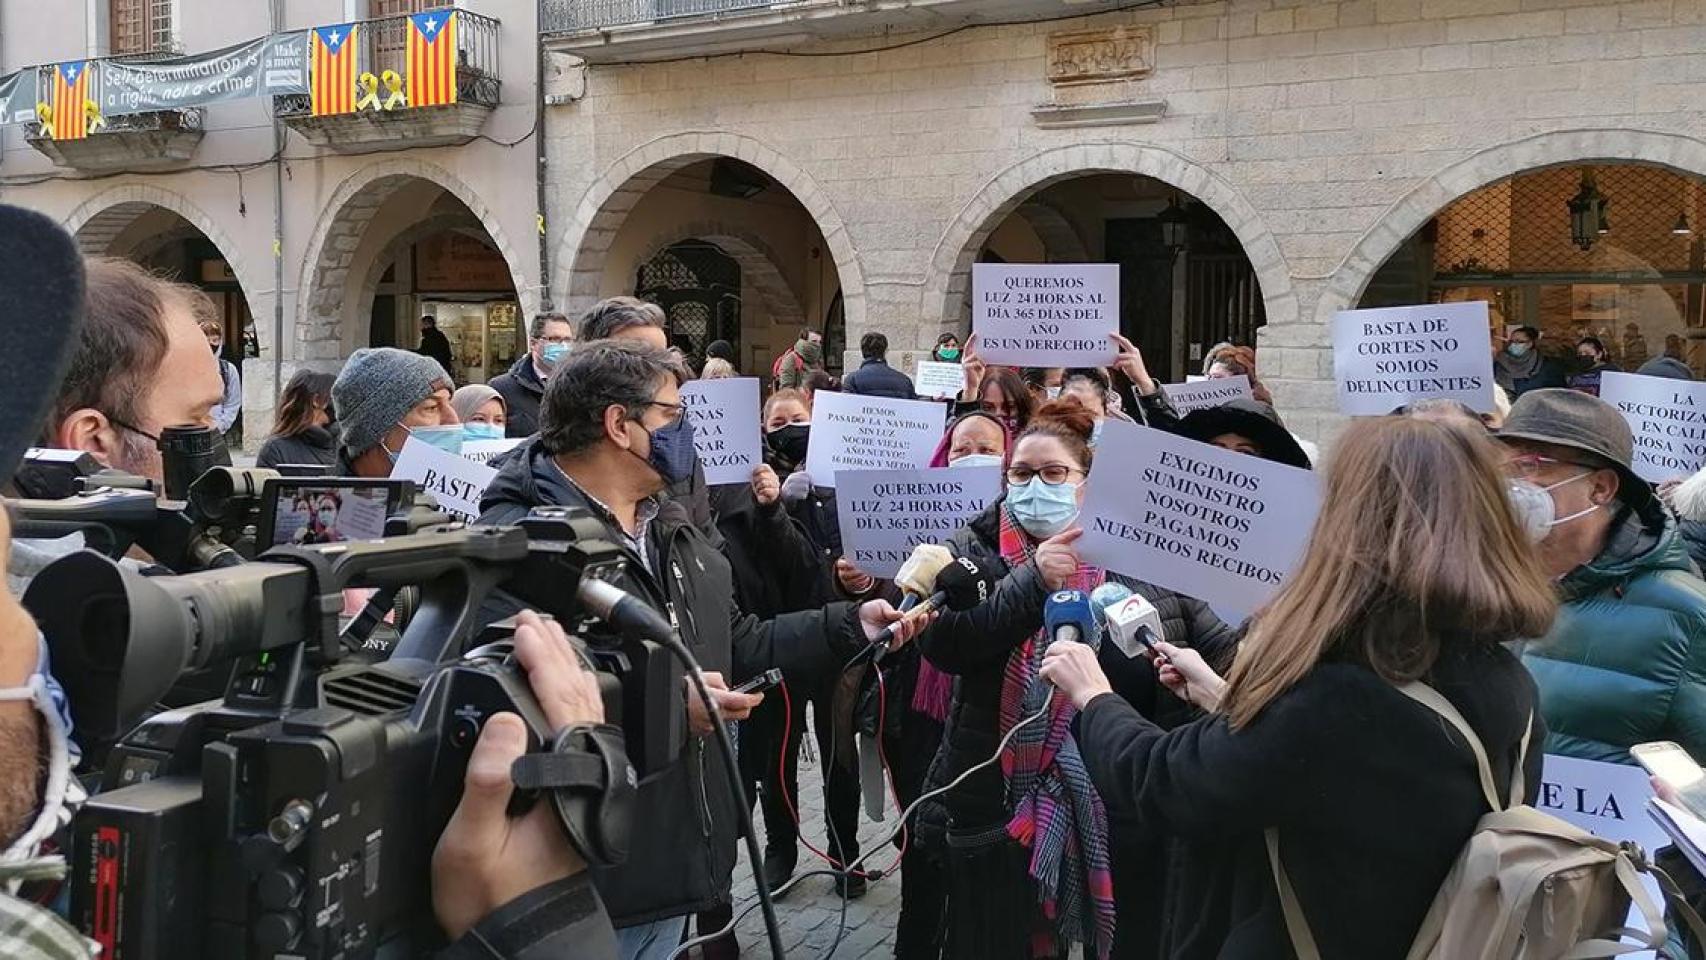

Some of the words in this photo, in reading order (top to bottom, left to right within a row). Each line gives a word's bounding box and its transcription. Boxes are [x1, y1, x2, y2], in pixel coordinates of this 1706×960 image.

[245, 49, 258, 66] is
[108, 94, 116, 106] a
[162, 81, 190, 100] not
[192, 84, 204, 96] a
[208, 73, 254, 95] crime
[1004, 277, 1084, 290] QUEREMOS
[985, 292, 1010, 304] LUZ
[1017, 293, 1031, 304] 24
[1034, 293, 1083, 304] HORAS
[1086, 293, 1107, 304] AL
[987, 305, 1010, 319] DÍA
[1014, 308, 1034, 319] 365
[1074, 308, 1104, 320] DEL
[1029, 322, 1060, 335] AÑO
[1363, 321, 1417, 337] BASTA
[1423, 318, 1450, 333] DE
[983, 338, 1000, 349] ES
[1003, 338, 1022, 349] UN
[1025, 339, 1095, 351] DERECHO
[1098, 340, 1107, 351] !!
[1357, 339, 1426, 356] CORTES
[1430, 338, 1459, 353] NO
[1375, 358, 1439, 375] SOMOS
[1345, 375, 1482, 394] DELINCUENTES
[1171, 386, 1243, 403] CIUDADANOS
[1673, 392, 1695, 406] LA
[861, 406, 897, 417] HEMOS
[827, 412, 865, 424] PASADO
[869, 418, 881, 426] LA
[885, 419, 929, 431] NAVIDAD
[1641, 421, 1662, 434] EN
[713, 425, 723, 435] A
[858, 427, 874, 436] SIN
[876, 428, 896, 437] LUZ
[842, 434, 874, 446] NOCHE
[846, 445, 866, 456] AÑO
[1682, 443, 1706, 457] NO
[842, 456, 875, 467] HORAS
[876, 459, 882, 467] Y
[885, 460, 916, 470] MEDIA
[1159, 451, 1261, 492] EXIGIMOS
[873, 481, 963, 497] QUEREMOS
[1141, 467, 1266, 515] SUMINISTRO
[852, 500, 882, 513] LUZ
[889, 500, 905, 513] 24
[908, 499, 963, 513] HORAS
[1143, 489, 1252, 533] NOSOTROS
[856, 514, 883, 530] DÍA
[887, 517, 910, 530] 365
[914, 514, 951, 530] DÍAS
[905, 530, 939, 546] AÑO
[1143, 510, 1242, 552] PAGAMOS
[855, 550, 874, 562] ES
[876, 550, 898, 562] UN
[1092, 516, 1194, 558] NUESTROS
[1196, 548, 1284, 586] RECIBOS
[1574, 786, 1625, 821] LA
